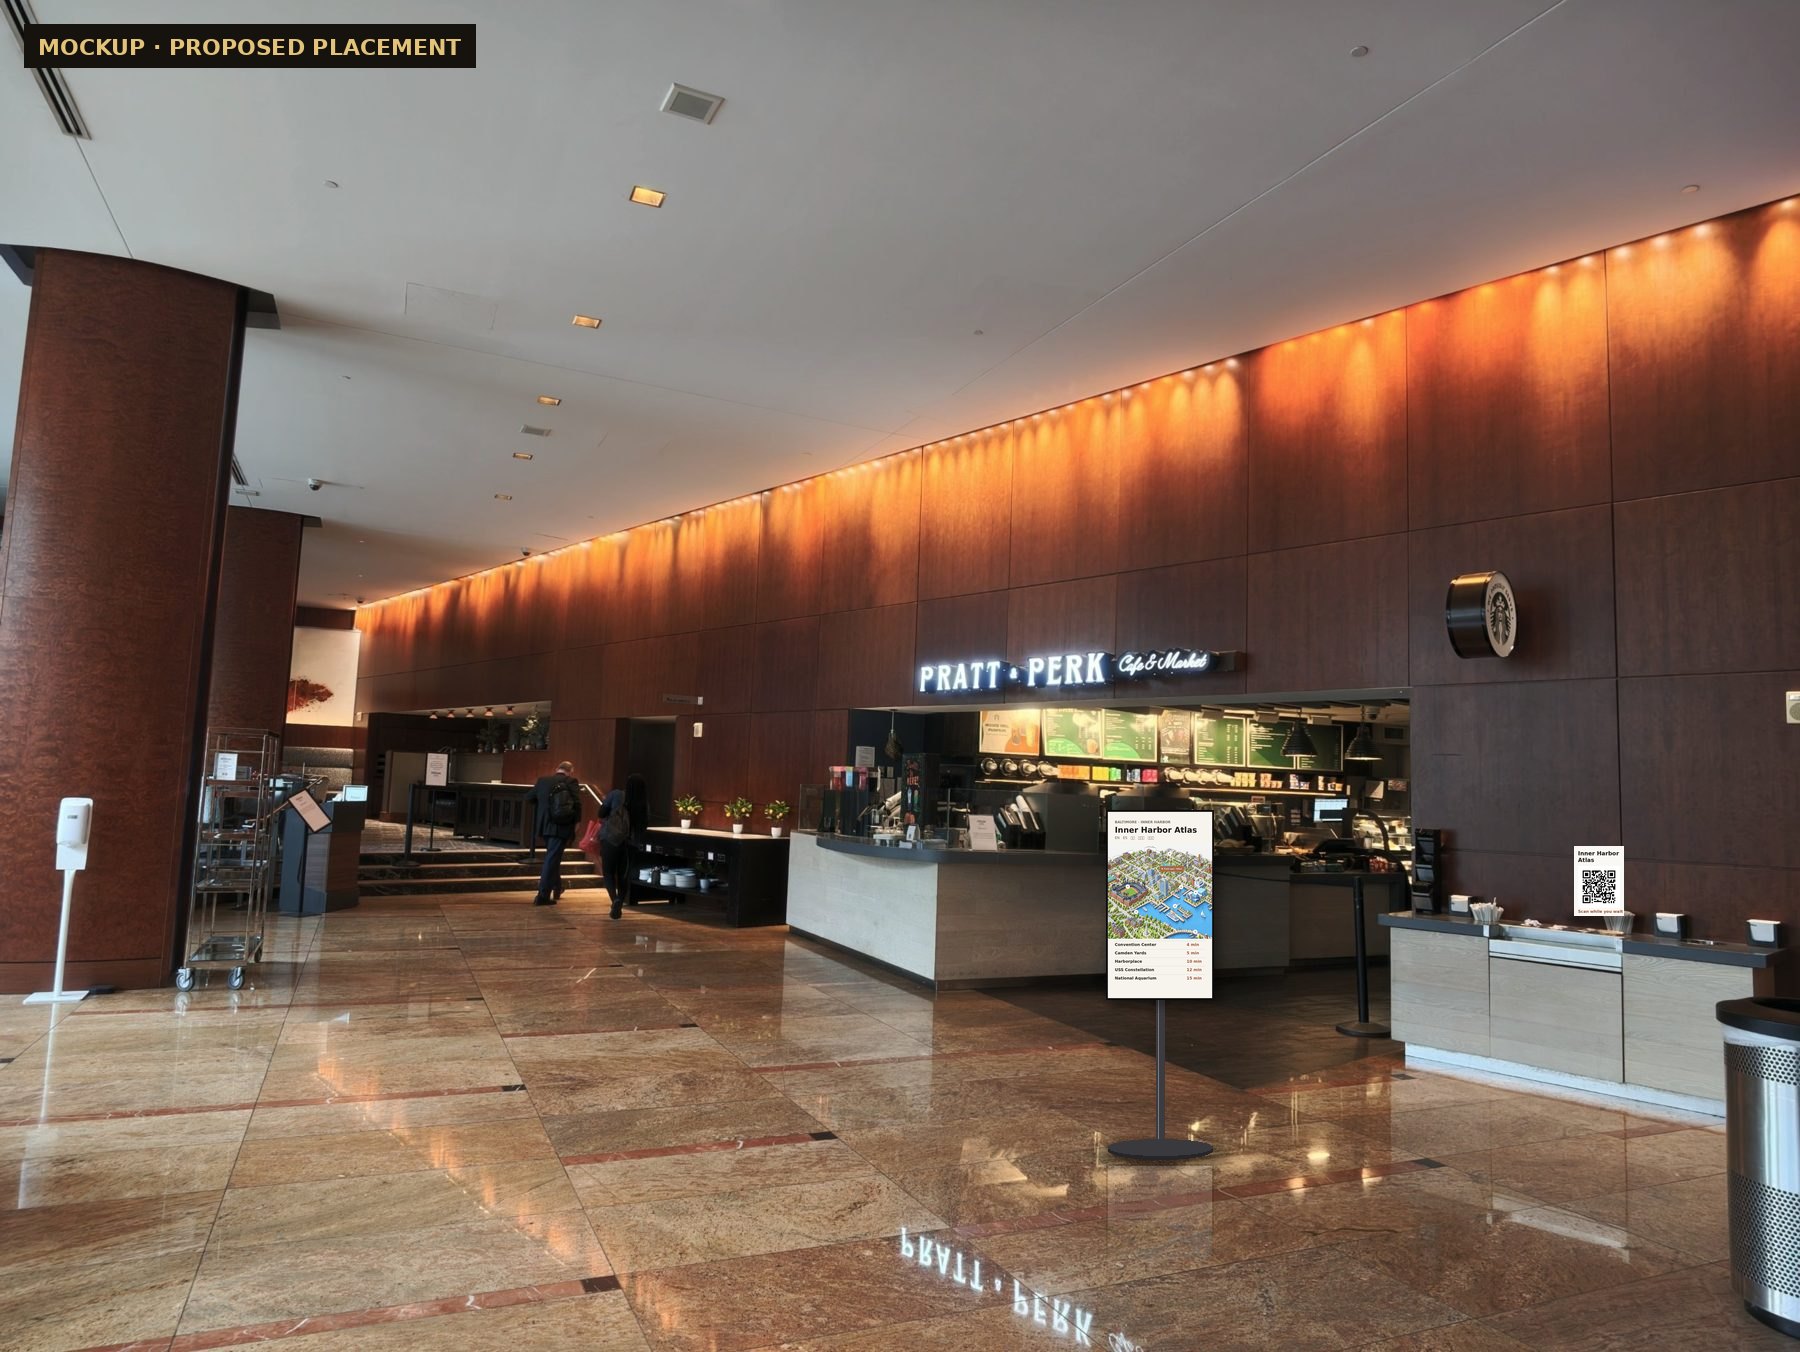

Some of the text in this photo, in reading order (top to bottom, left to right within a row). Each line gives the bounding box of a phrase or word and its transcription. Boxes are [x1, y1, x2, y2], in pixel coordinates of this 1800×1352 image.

[1145, 653, 1157, 670] &
[1157, 651, 1208, 670] Market
[919, 652, 1105, 692] PRATT & PERK
[1141, 826, 1172, 834] Harbor
[1174, 826, 1198, 834] Atlas
